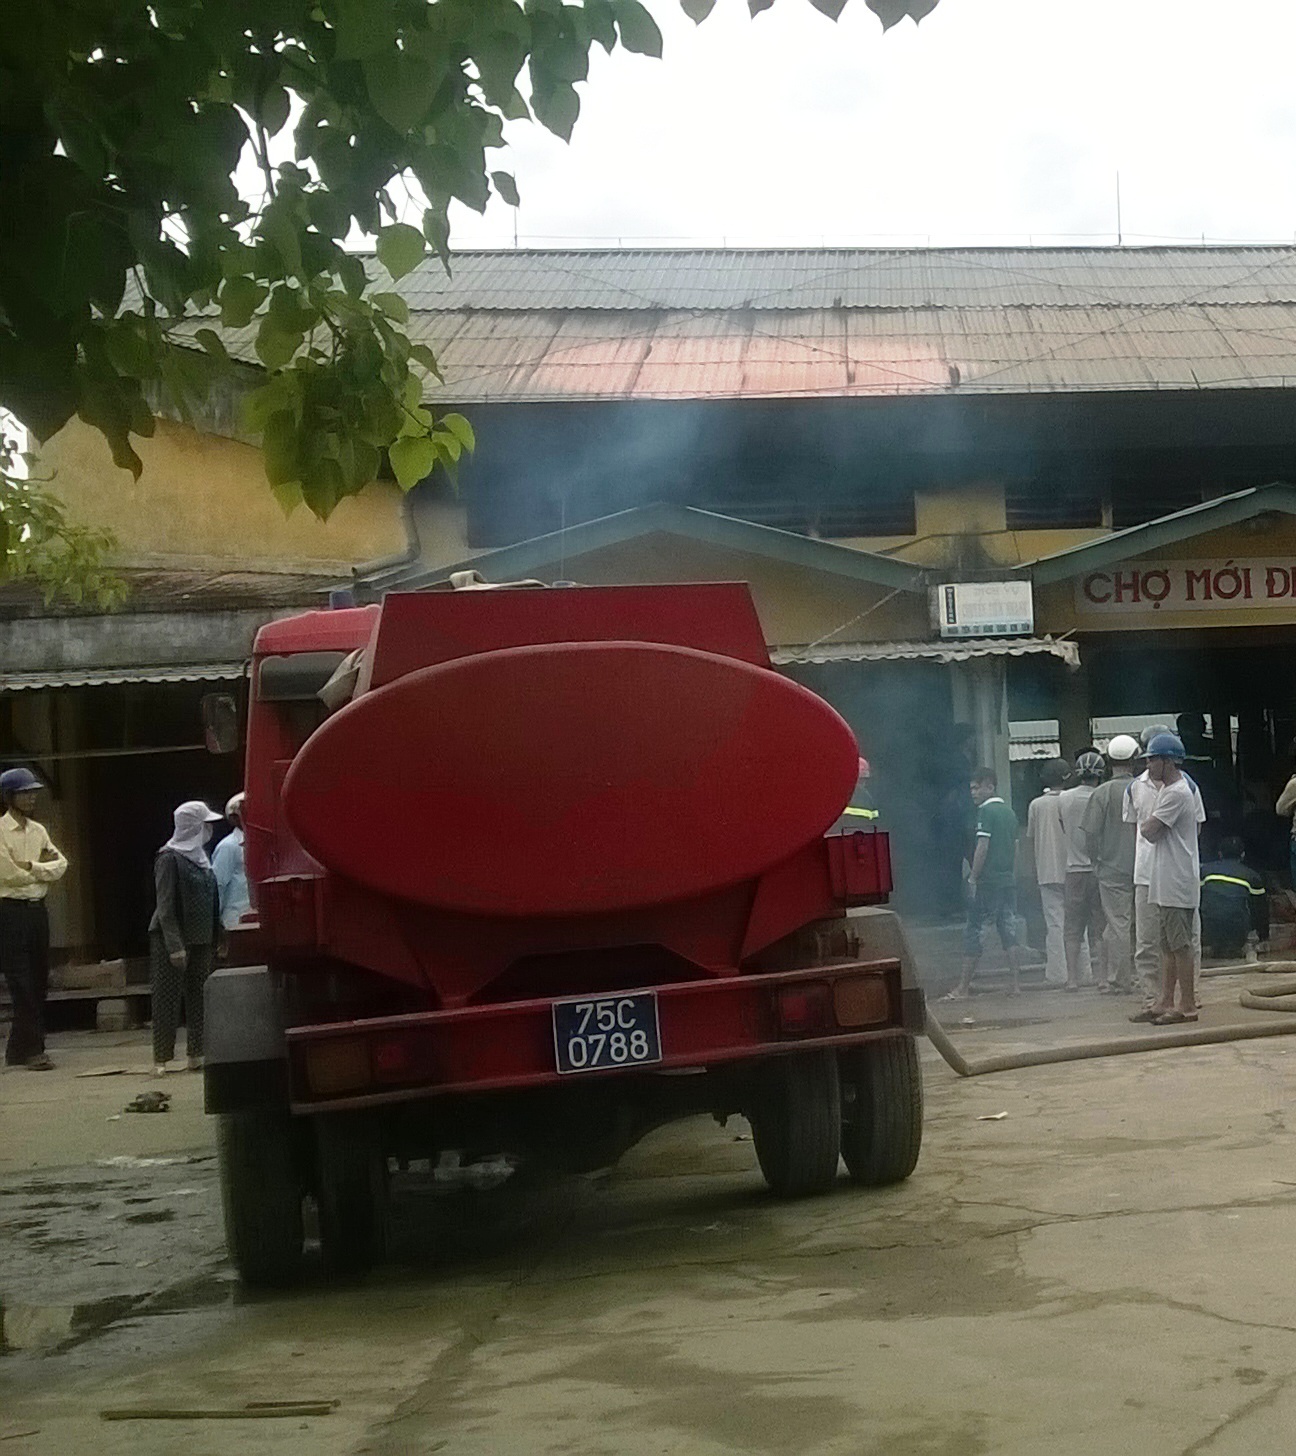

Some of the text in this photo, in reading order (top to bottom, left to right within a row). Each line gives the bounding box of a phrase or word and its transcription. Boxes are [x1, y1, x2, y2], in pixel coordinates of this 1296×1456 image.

[1083, 568, 1172, 609] CHỢ
[1184, 560, 1253, 601] MỚI
[575, 999, 637, 1032] 75C
[568, 1029, 649, 1068] 0788
